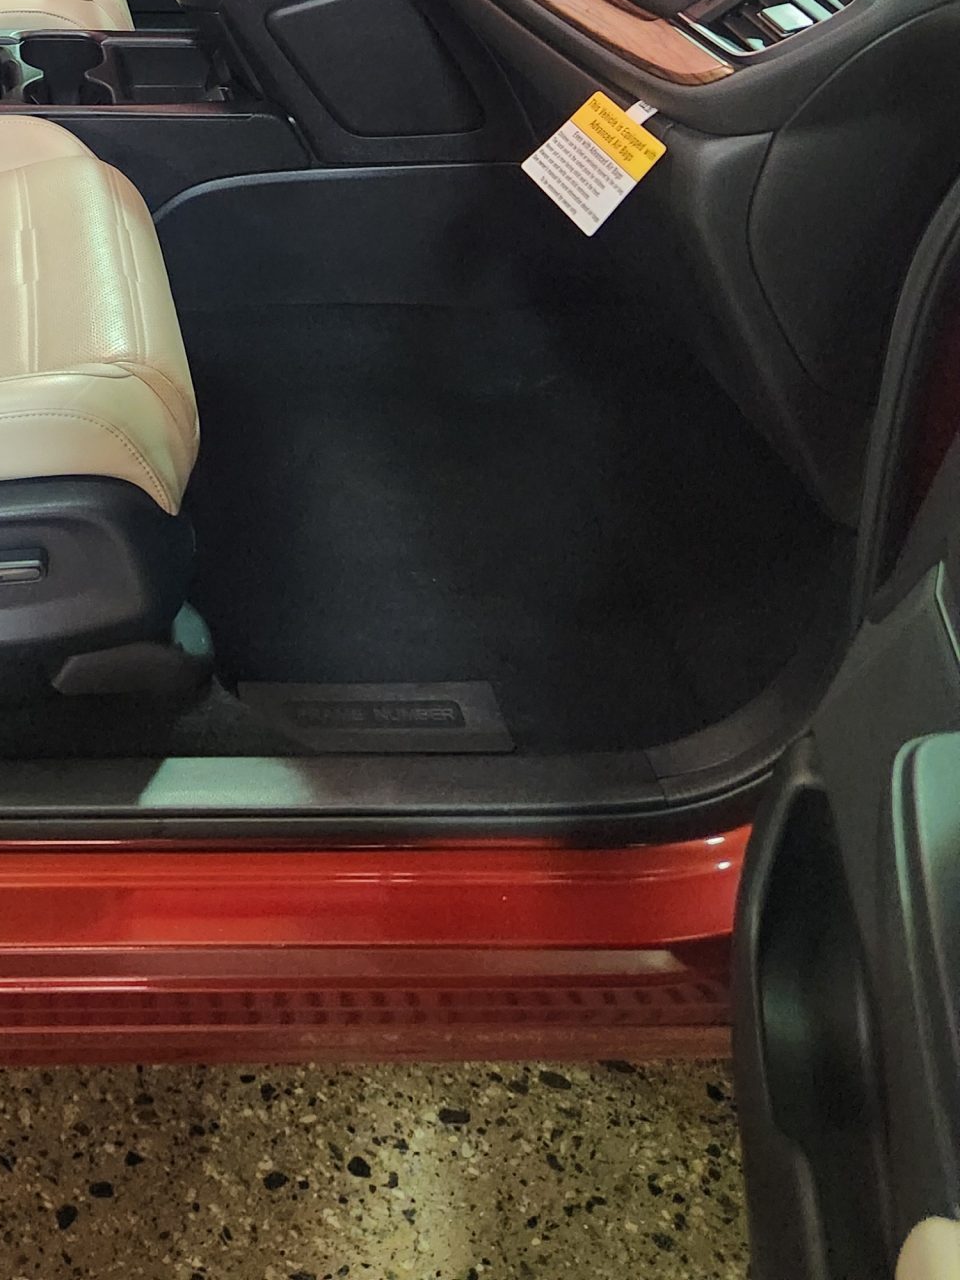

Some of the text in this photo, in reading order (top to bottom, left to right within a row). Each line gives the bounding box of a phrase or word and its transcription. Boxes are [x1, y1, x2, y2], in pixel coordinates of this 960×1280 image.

[588, 99, 602, 111] This
[598, 108, 618, 126] Vehicle
[619, 127, 646, 151] Equipped
[643, 147, 656, 160] with
[589, 119, 634, 162] Advanced Air Bags
[373, 708, 455, 720] NUMBER
